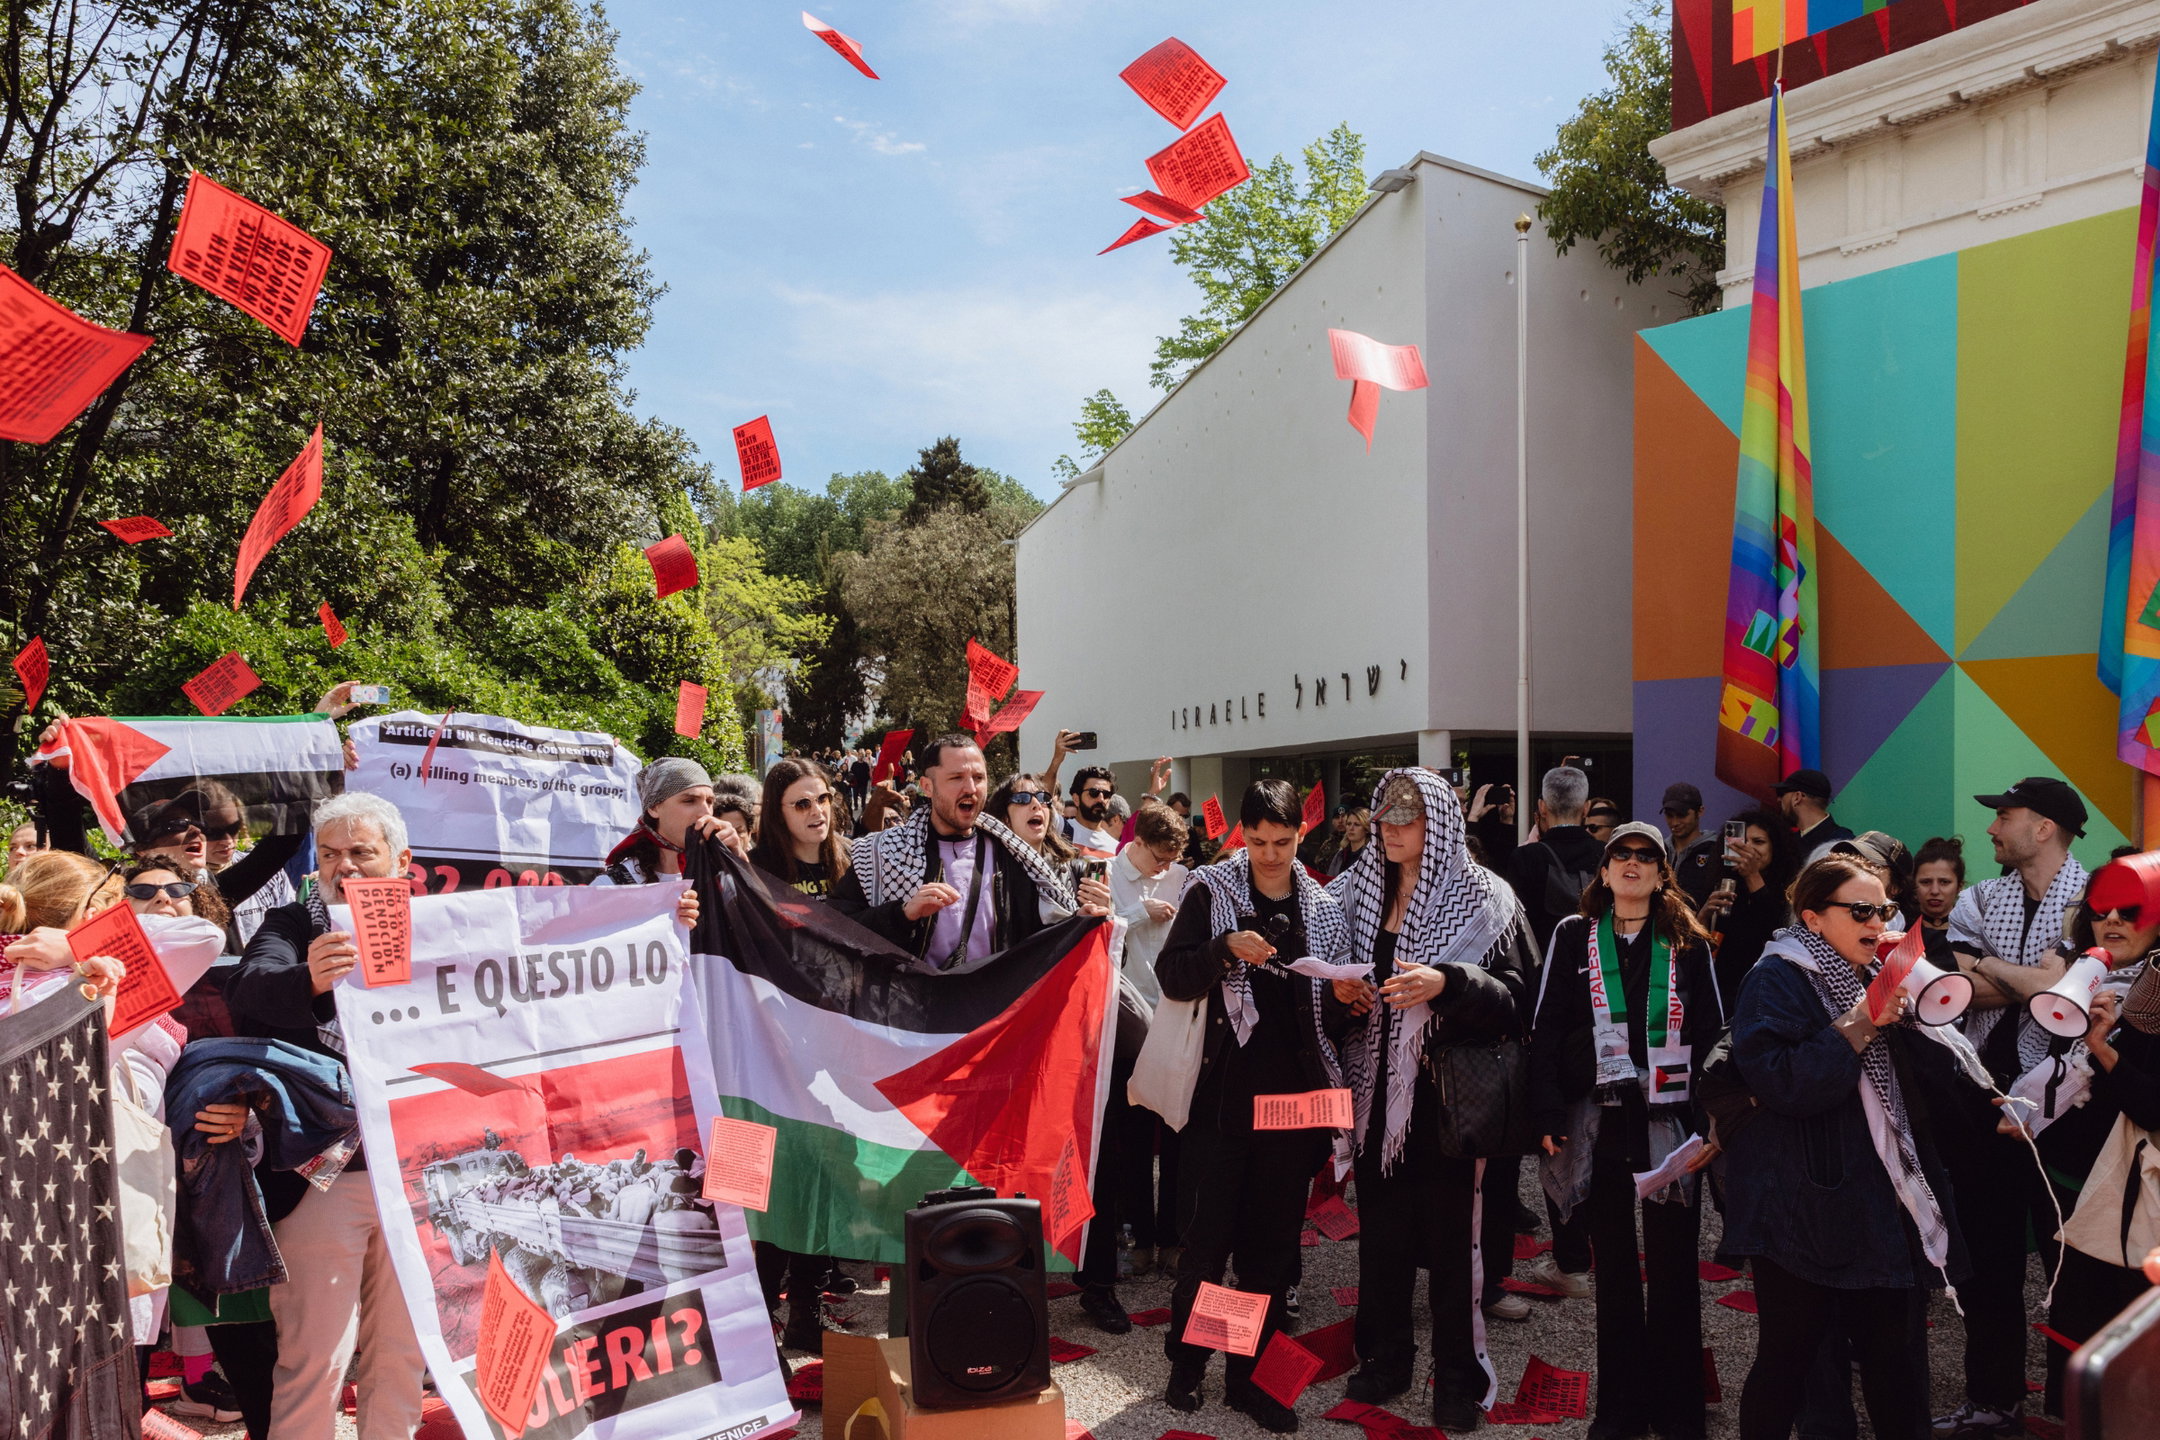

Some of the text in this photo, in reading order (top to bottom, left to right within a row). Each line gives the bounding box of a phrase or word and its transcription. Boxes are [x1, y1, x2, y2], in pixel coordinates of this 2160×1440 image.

[182, 249, 202, 273] NO
[201, 233, 228, 283] DEATH
[222, 218, 257, 296] IN VENICE
[242, 232, 277, 306] NO TO THE
[259, 238, 296, 316] GENOCIDE
[274, 244, 314, 328] PAVILION
[737, 430, 745, 438] NO
[739, 434, 757, 448] DEATH
[748, 440, 769, 453] VENICE
[743, 450, 771, 467] NO TO THE
[744, 458, 774, 474] GENOCIDE
[745, 466, 777, 483] PAVILION
[1294, 658, 1407, 709] ישראל
[1172, 692, 1265, 730] ISRAELE
[386, 725, 435, 738] Article
[457, 729, 474, 741] UN
[479, 732, 534, 754] Genocide
[536, 744, 609, 758] Convention:
[390, 762, 411, 780] (a)
[474, 773, 539, 789] members
[542, 778, 554, 790] of
[555, 779, 576, 792] the
[581, 785, 623, 799] group;
[790, 880, 818, 894] NG
[358, 888, 385, 973] PAVILION
[371, 888, 395, 967] GENOCIDE
[384, 888, 401, 961] NO TO THE
[436, 964, 461, 1015] E
[473, 946, 616, 1019] QUESTO
[627, 939, 669, 988] LO
[1588, 918, 1607, 1008] PALESTIN
